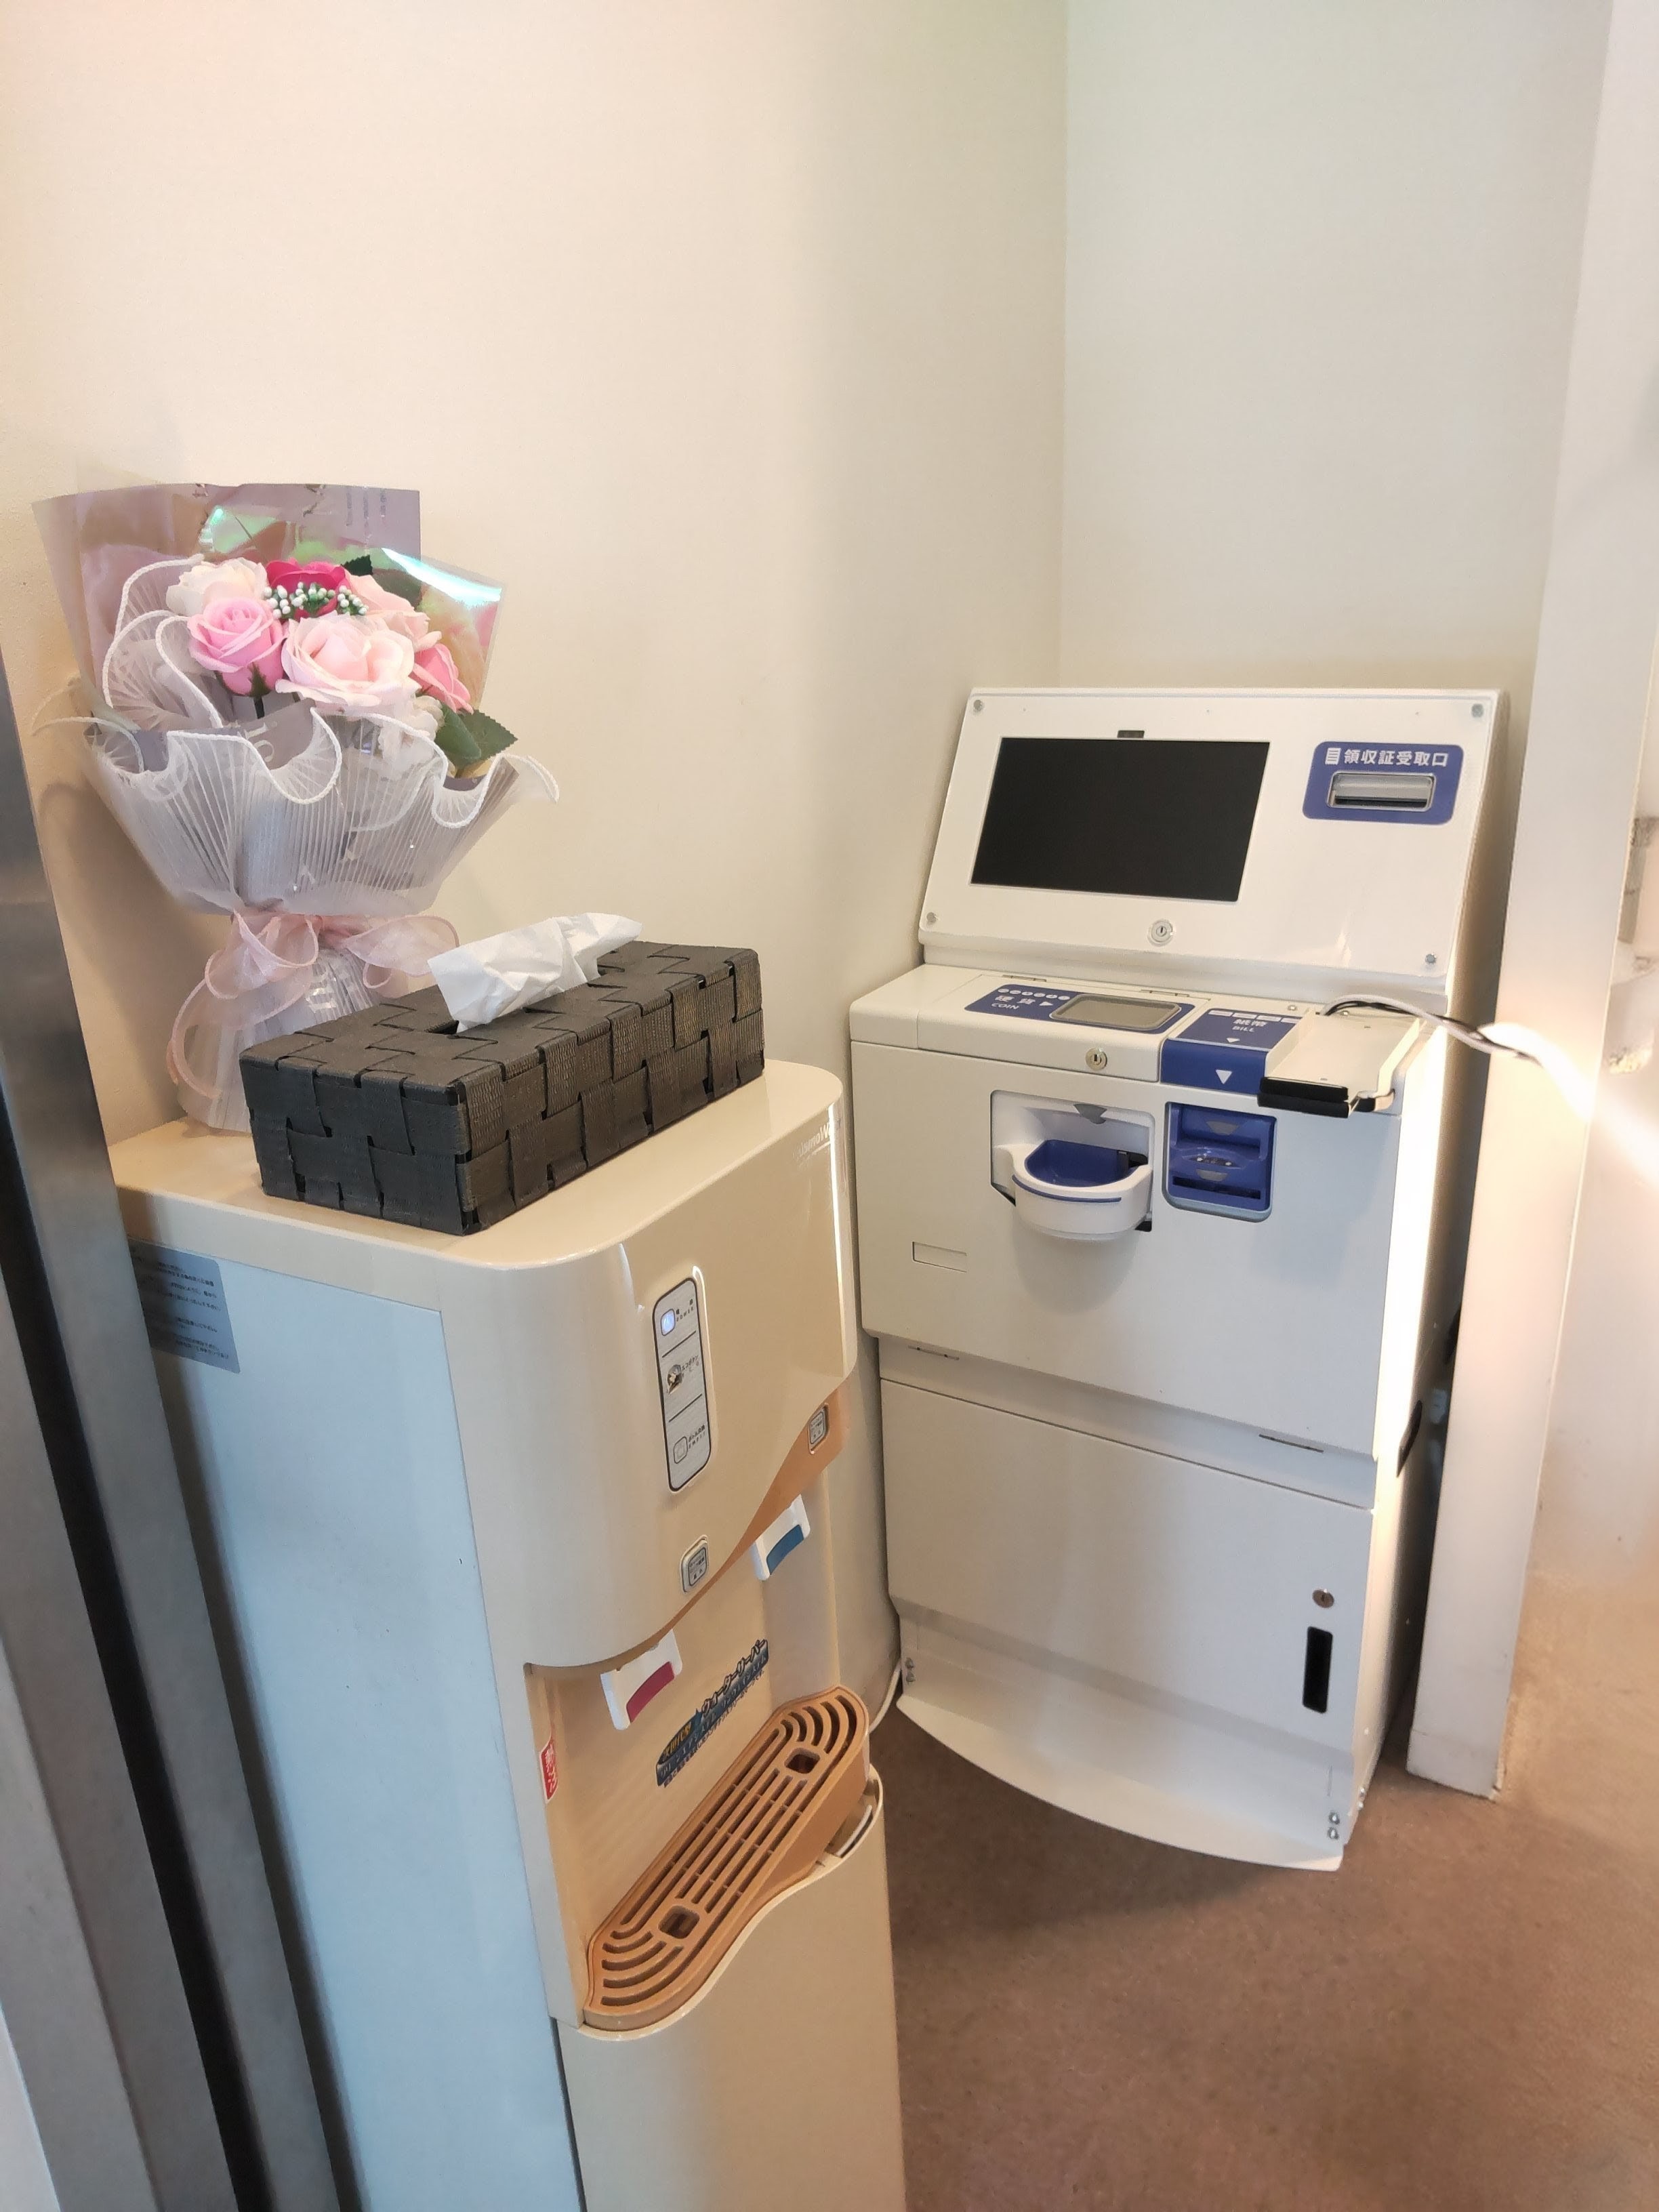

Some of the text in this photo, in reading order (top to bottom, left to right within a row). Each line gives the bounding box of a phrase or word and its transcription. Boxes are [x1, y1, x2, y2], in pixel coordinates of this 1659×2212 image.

[1345, 748, 1448, 767] 領収証受取口
